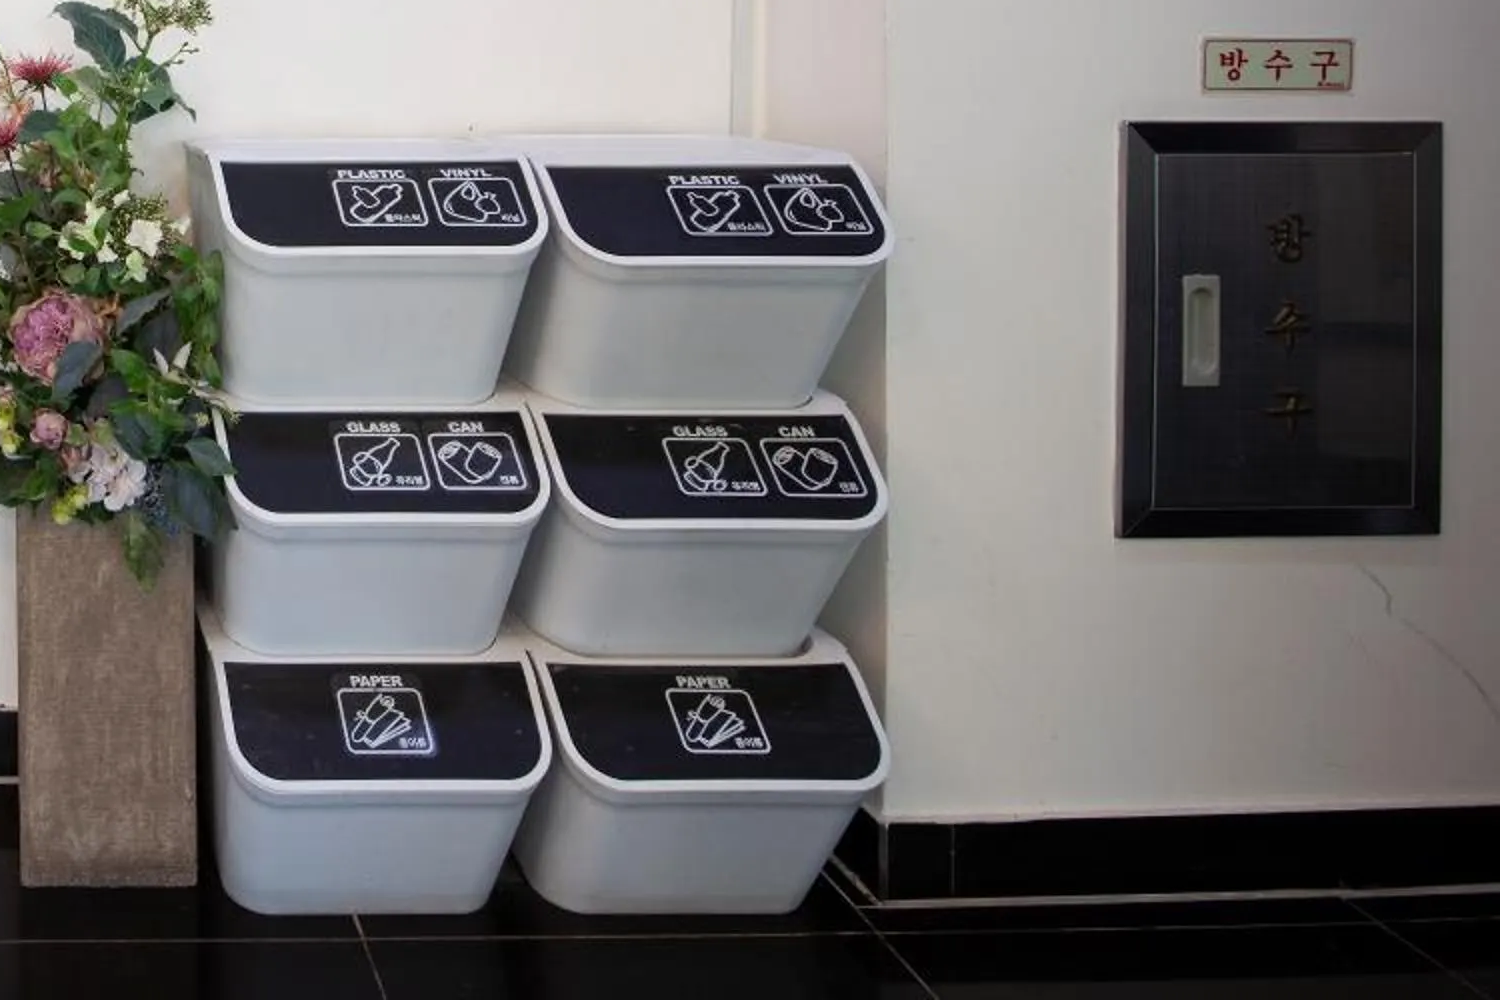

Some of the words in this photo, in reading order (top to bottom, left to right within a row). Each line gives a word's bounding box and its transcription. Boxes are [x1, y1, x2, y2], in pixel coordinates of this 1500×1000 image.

[337, 169, 407, 179] PLASTIC
[440, 168, 493, 177] VINYL
[668, 175, 740, 185] PLASTIC
[773, 174, 828, 184] VINYL
[346, 421, 401, 433] GLASS
[448, 421, 485, 433] CAN
[672, 425, 728, 437] GLASS
[778, 425, 816, 437] CAN
[350, 674, 403, 687] PAPER
[675, 675, 731, 689] PAPER
